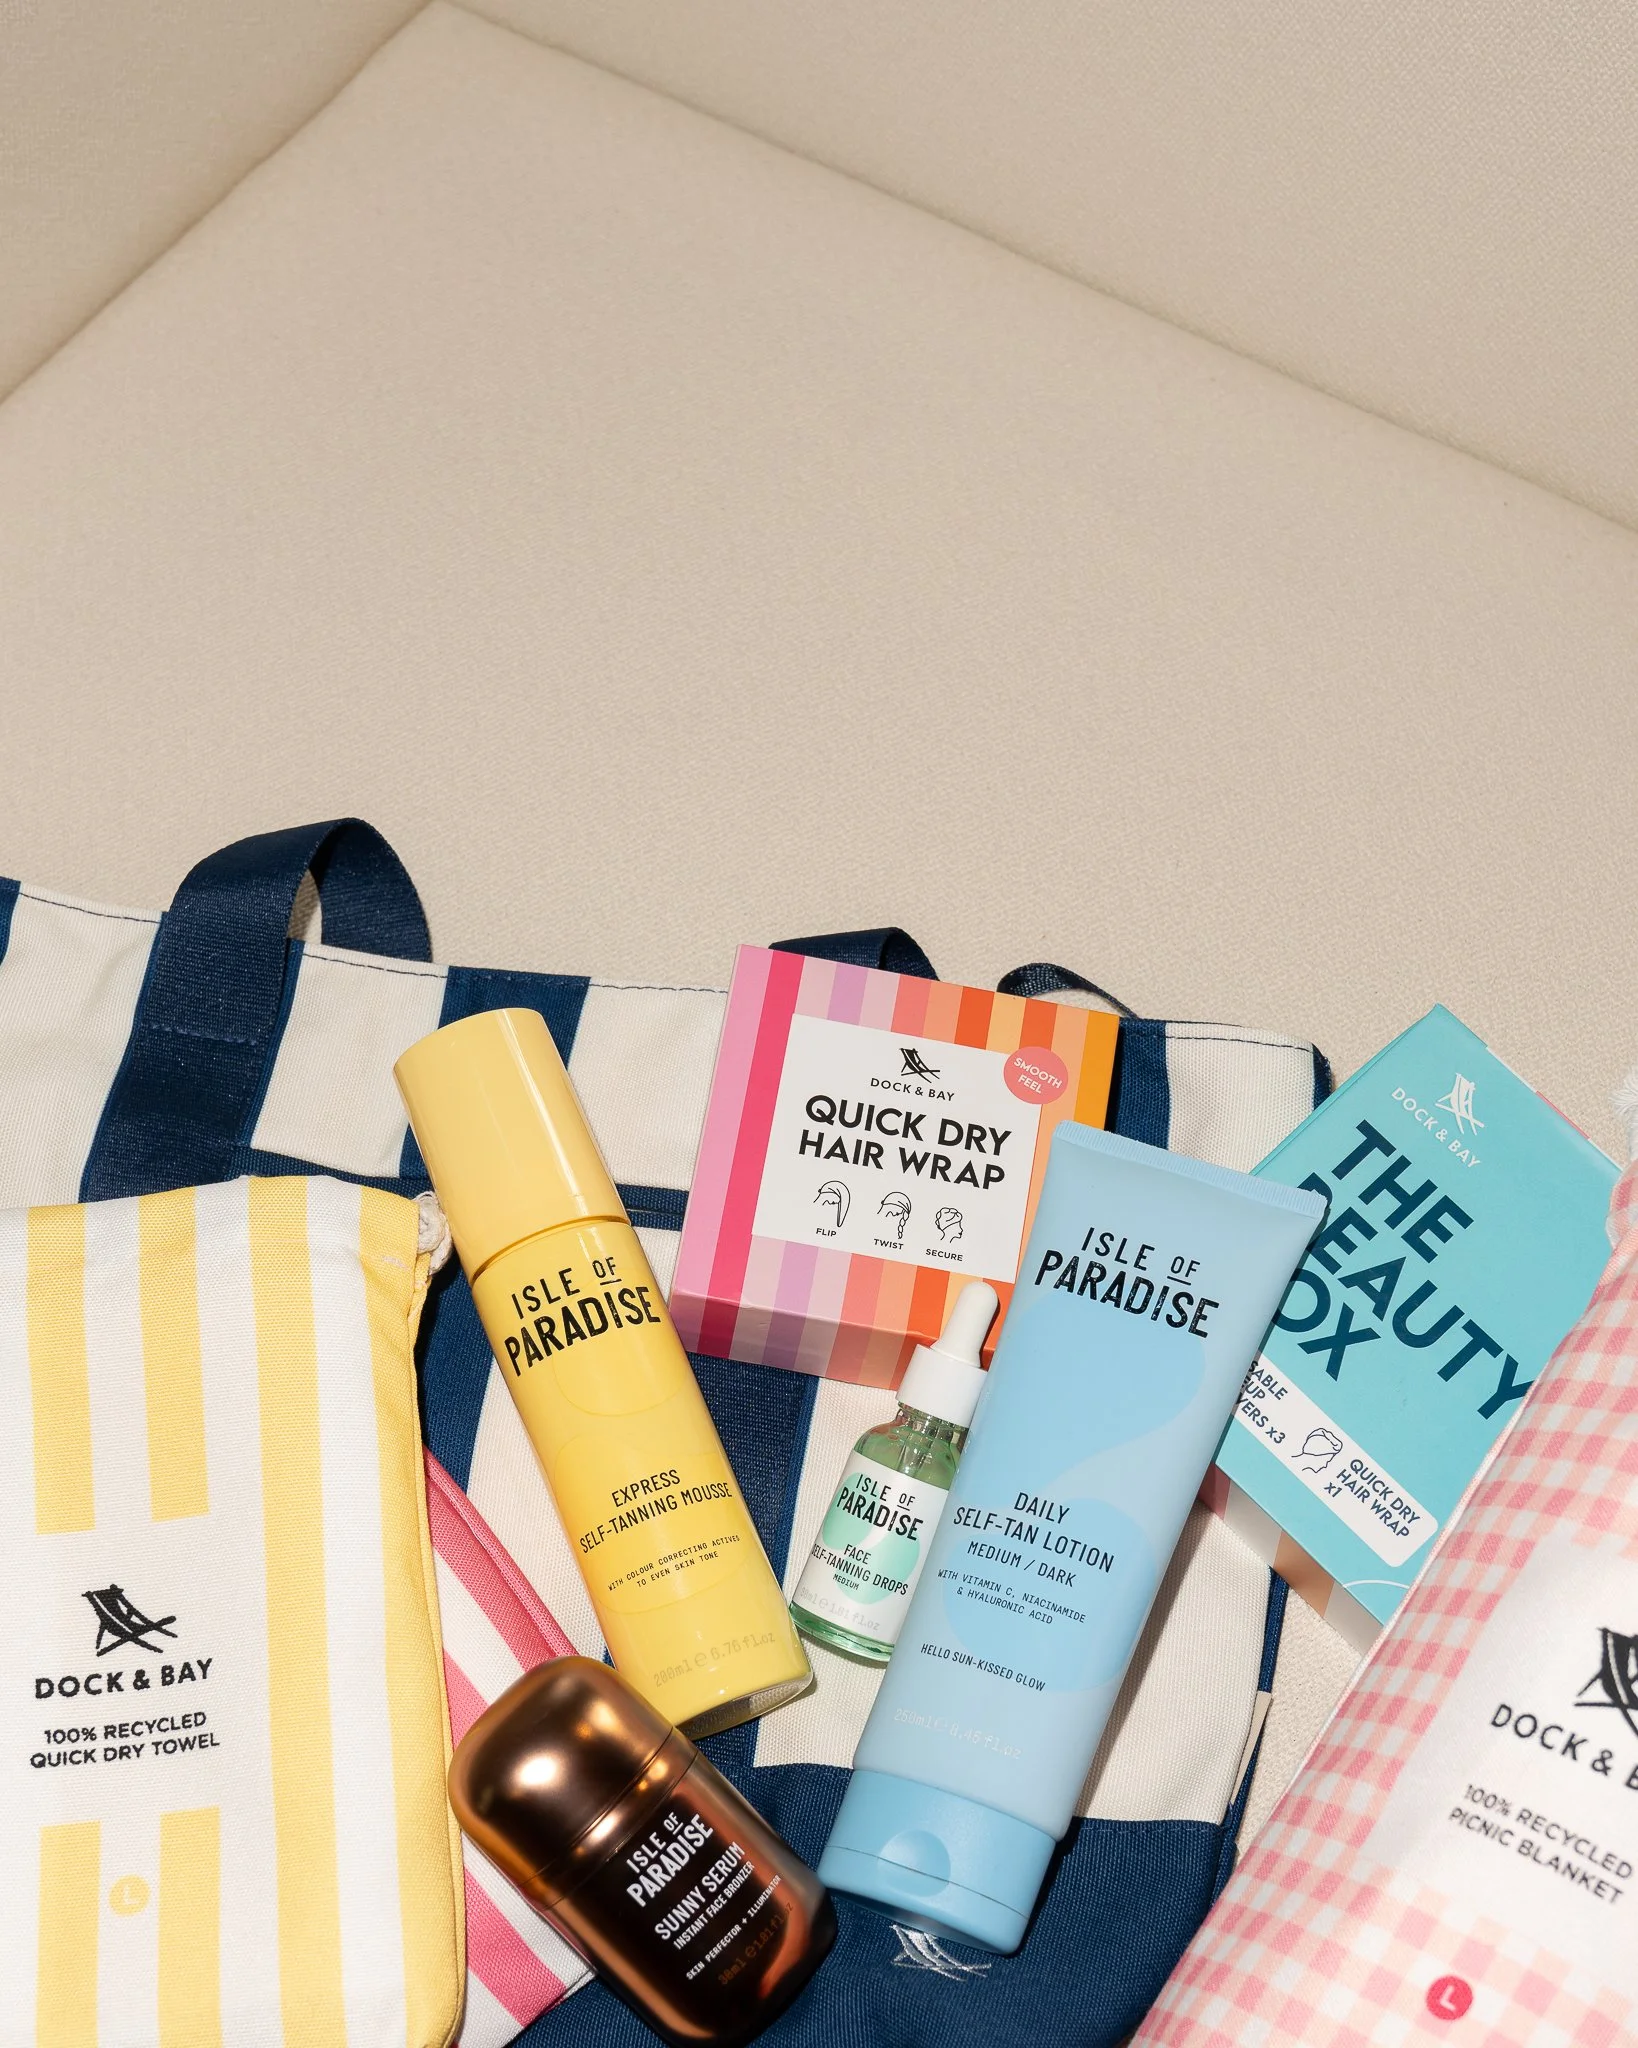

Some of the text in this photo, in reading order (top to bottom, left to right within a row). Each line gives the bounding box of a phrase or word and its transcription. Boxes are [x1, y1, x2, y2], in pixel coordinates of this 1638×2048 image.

[870, 1078, 955, 1102] DOCK & BAY
[1013, 1057, 1063, 1089] SMOOTH
[1018, 1074, 1042, 1095] FEEL
[805, 1094, 1012, 1156] QUICK DRY
[1391, 1087, 1481, 1169] DOCK & BAY
[799, 1129, 1005, 1190] HAIR WRAP
[1331, 1119, 1474, 1264] THE
[816, 1227, 837, 1237] FLIP
[873, 1238, 904, 1250] TWIST
[925, 1248, 964, 1261] SECURE
[1081, 1227, 1200, 1277] ISLE OF
[511, 1257, 617, 1319] ISLE OF
[1035, 1249, 1219, 1339] PARADISE
[504, 1286, 661, 1377] PARADISE
[1271, 1268, 1382, 1382] OX
[1248, 1360, 1288, 1401] SABLE
[1236, 1392, 1286, 1444] VERS x3
[611, 1469, 681, 1507] EXPRESS
[855, 1474, 916, 1507] ISLE OF
[1014, 1492, 1070, 1525] DAILY
[1324, 1482, 1343, 1498] x1
[1336, 1469, 1410, 1537] HAIR WRAP
[1349, 1459, 1421, 1525] QUICK DRY
[580, 1482, 732, 1553] SELF-TANNING MOUSSE
[836, 1487, 923, 1541] PARADISE
[608, 1535, 741, 1591] WITH COLOUR CORRECTING ACTIVES
[843, 1544, 871, 1565] FACE
[953, 1506, 1115, 1573] SELF-TAN LOTION
[967, 1541, 1077, 1588] MEDIUM / DARK
[637, 1551, 719, 1588] TO EVEN SKIN TONE
[833, 1573, 859, 1590] MEDIUM
[873, 1574, 909, 1596] DROPS
[938, 1569, 958, 1581] WITH
[963, 1574, 1002, 1593] VITAMIN
[1022, 1593, 1086, 1624] NIACINAMIDE
[957, 1587, 1053, 1625] & HYALURONIC ACID
[35, 1658, 212, 1699] DOCK & BAY
[653, 1659, 693, 1688] 200ml
[710, 1639, 741, 1661] 6.76
[920, 1643, 1046, 1692] HELLO SUN-KISSED GLOW
[30, 1733, 220, 1768] QUICK DRY TOWEL
[44, 1712, 206, 1744] 100% RECYCLED
[1490, 1704, 1589, 1761] DOCK
[1591, 1750, 1614, 1777] &
[626, 1812, 679, 1874] ISLE OF
[1448, 1806, 1624, 1904] PICNIC BLANKET
[1464, 1784, 1634, 1881] 100% RECYCLED
[626, 1814, 714, 1907] PARADISE
[123, 1885, 138, 1905] L
[655, 1841, 746, 1940] SUNNY SERUM
[673, 1861, 755, 1950] INSTANT FACE BRONZER
[686, 1960, 705, 1980] SKIN
[705, 1924, 742, 1962] PERFECTOR
[747, 1874, 781, 1917] ILLUMINATOR
[1441, 1985, 1456, 2011] L
